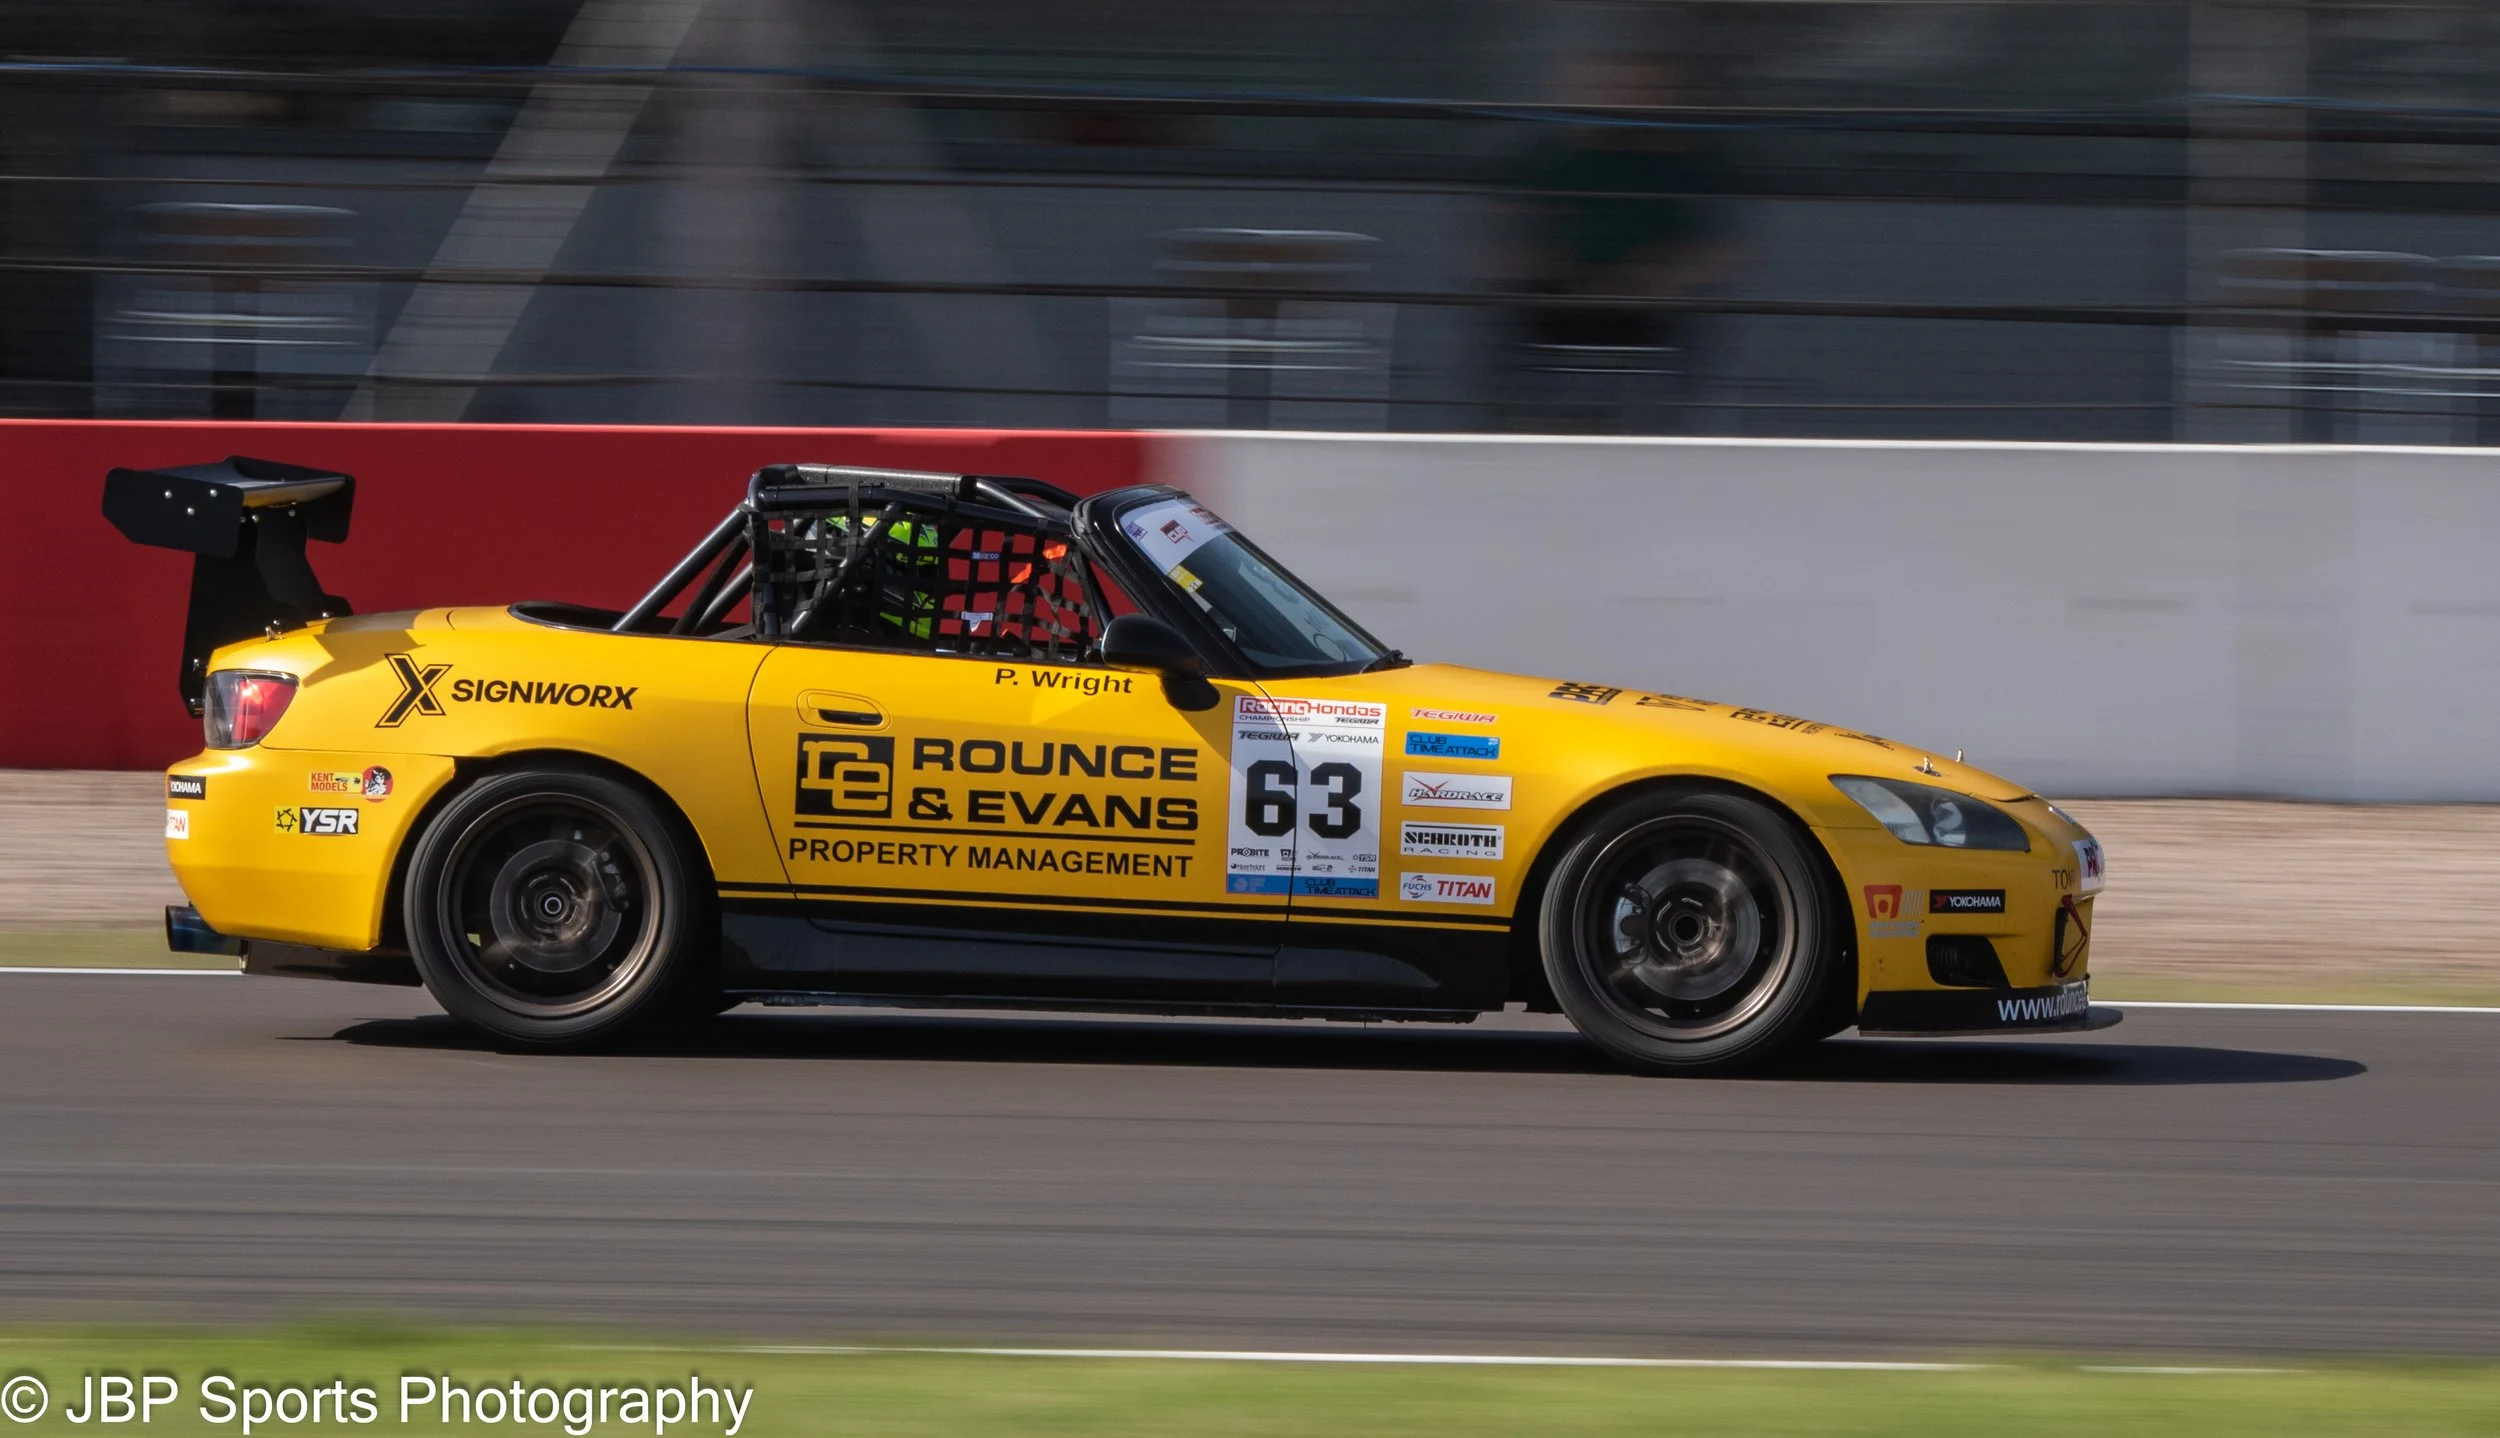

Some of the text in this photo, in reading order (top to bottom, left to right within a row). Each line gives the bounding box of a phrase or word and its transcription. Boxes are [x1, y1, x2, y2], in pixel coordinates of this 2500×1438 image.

[995, 668, 1133, 696] P. Wright
[451, 679, 639, 710] SIGNWORX
[1238, 730, 1300, 742] TEGIWA
[1325, 734, 1380, 745] YOKOHAMA
[1409, 734, 1447, 745] CLUB
[913, 738, 1198, 782] ROUNCE
[311, 772, 335, 782] KENT
[311, 782, 348, 792] MODELS
[1245, 759, 1362, 840] 63
[1408, 788, 1504, 802] HARDRACE
[908, 787, 1199, 832] & EVANS
[302, 808, 358, 834] YSR
[1404, 831, 1497, 848] SCHROTH
[789, 838, 1194, 878] PROPERTY MANAGEMENT
[1403, 847, 1497, 857] RACING
[1305, 877, 1336, 888] CLUB
[1403, 880, 1492, 898] FUCHS TITAN
[1949, 896, 2001, 908] YOKOHAMA
